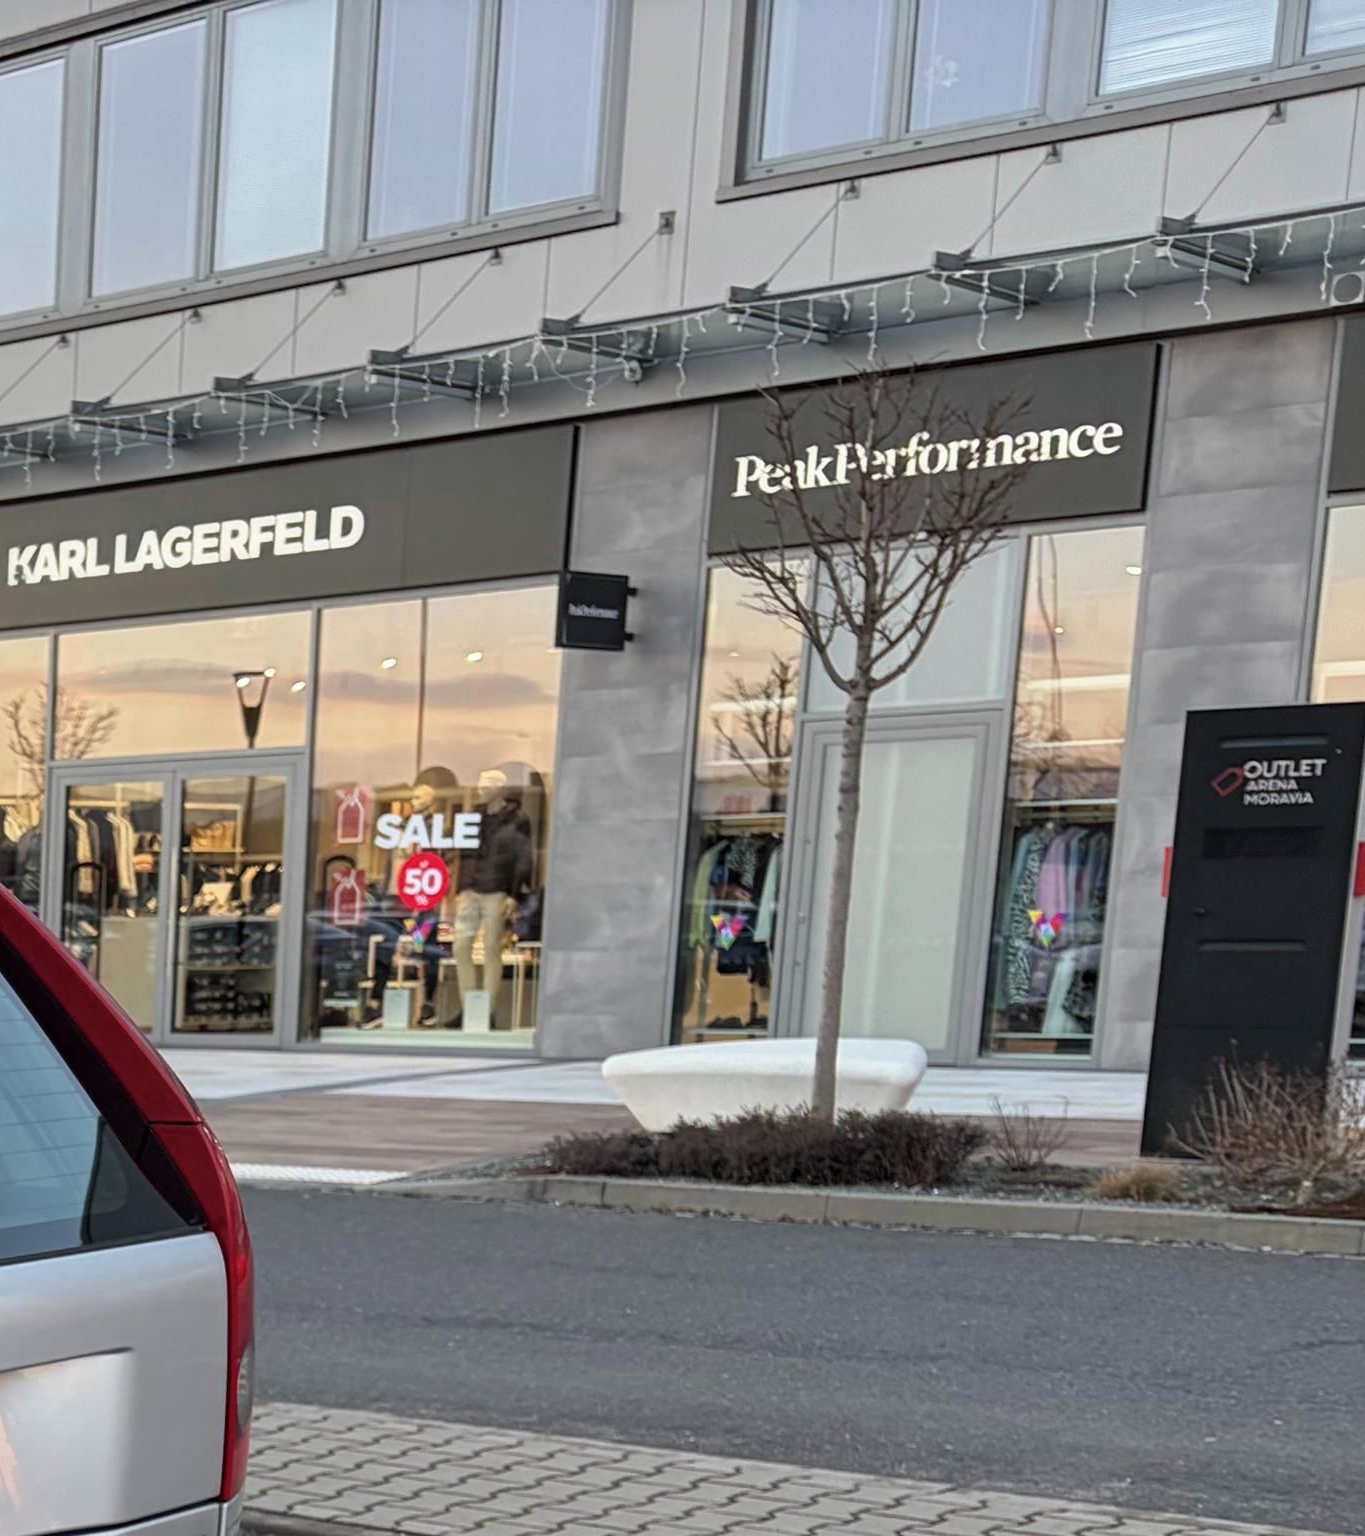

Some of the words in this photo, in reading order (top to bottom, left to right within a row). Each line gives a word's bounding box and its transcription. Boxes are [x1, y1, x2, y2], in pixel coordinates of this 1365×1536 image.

[7, 537, 110, 586] KARL
[113, 504, 365, 574] LAGERFELD
[1243, 758, 1328, 778] OUTLET
[1245, 779, 1299, 791] ARENA
[1243, 791, 1315, 806] MORAVIA
[374, 812, 482, 849] SALE
[403, 868, 443, 895] 50
